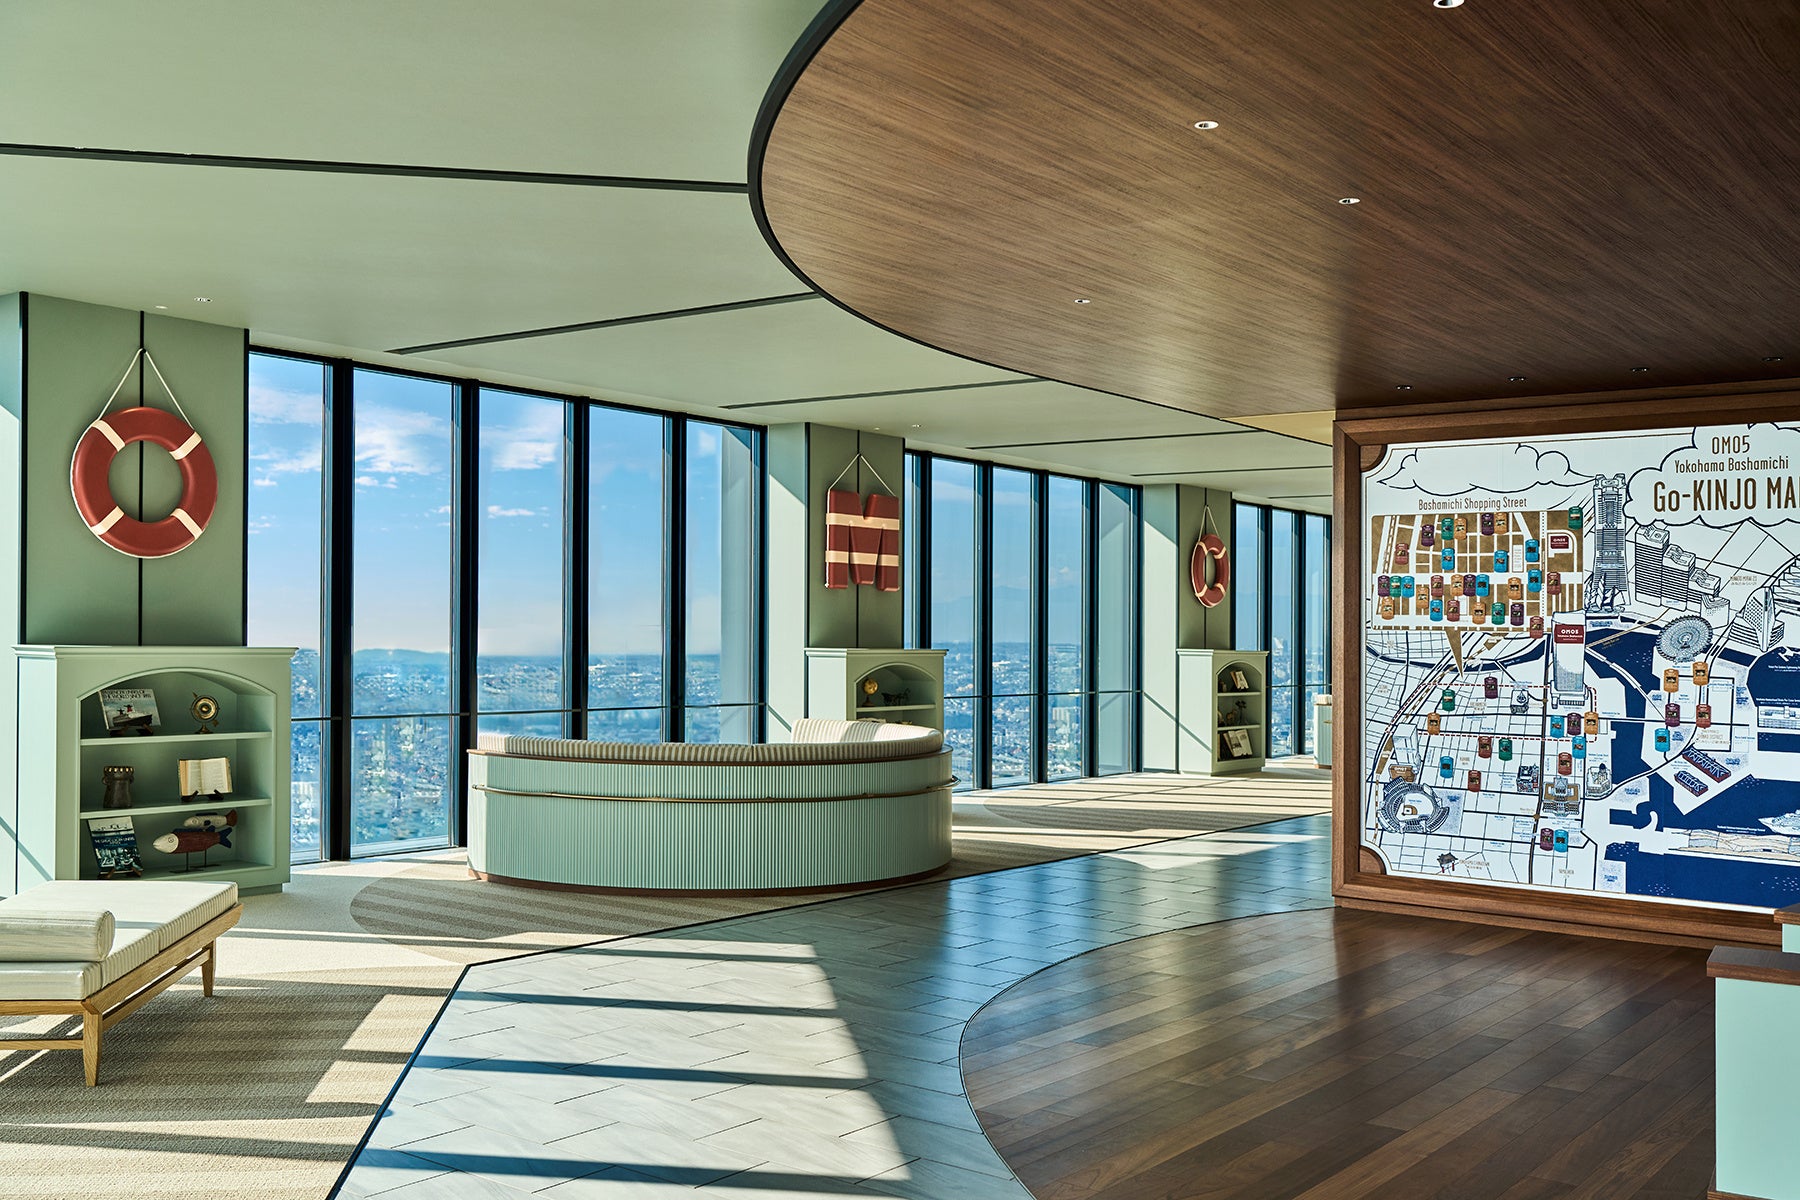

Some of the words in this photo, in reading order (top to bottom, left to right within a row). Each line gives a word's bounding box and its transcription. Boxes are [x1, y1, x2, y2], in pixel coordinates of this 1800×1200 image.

[1711, 435, 1750, 455] OMO5
[1674, 459, 1725, 473] Yokohama
[1728, 456, 1789, 471] Bashamichi
[1653, 477, 1757, 512] Go-KINJO
[1766, 476, 1800, 509] MA
[1418, 499, 1463, 511] Bashamichi
[1464, 497, 1501, 511] Shopping
[1502, 496, 1528, 508] Street
